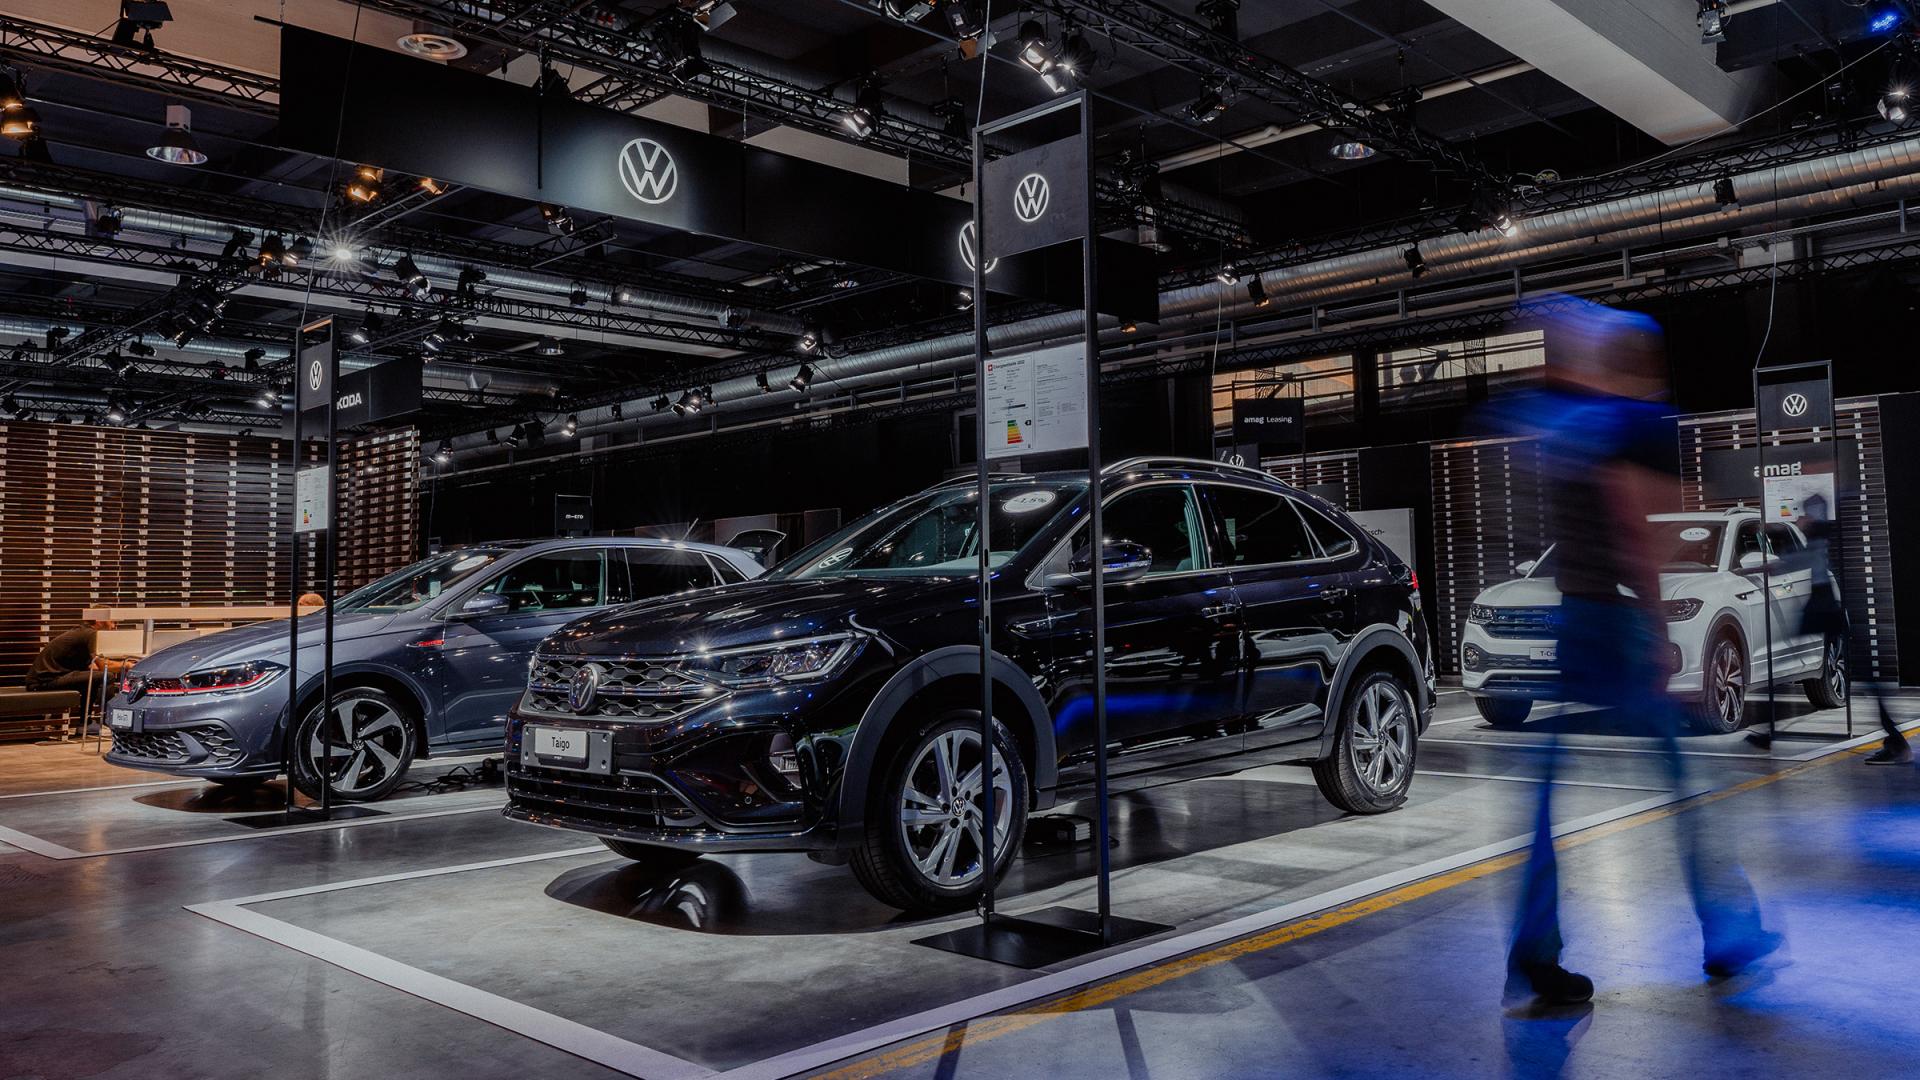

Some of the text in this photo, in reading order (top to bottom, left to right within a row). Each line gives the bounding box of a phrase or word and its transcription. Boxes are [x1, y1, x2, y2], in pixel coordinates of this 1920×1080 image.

[619, 138, 678, 204] VW
[1014, 173, 1049, 222] VW
[336, 392, 362, 410] KODA
[1244, 415, 1293, 425] amag Leasing
[551, 736, 570, 752] Taigo
